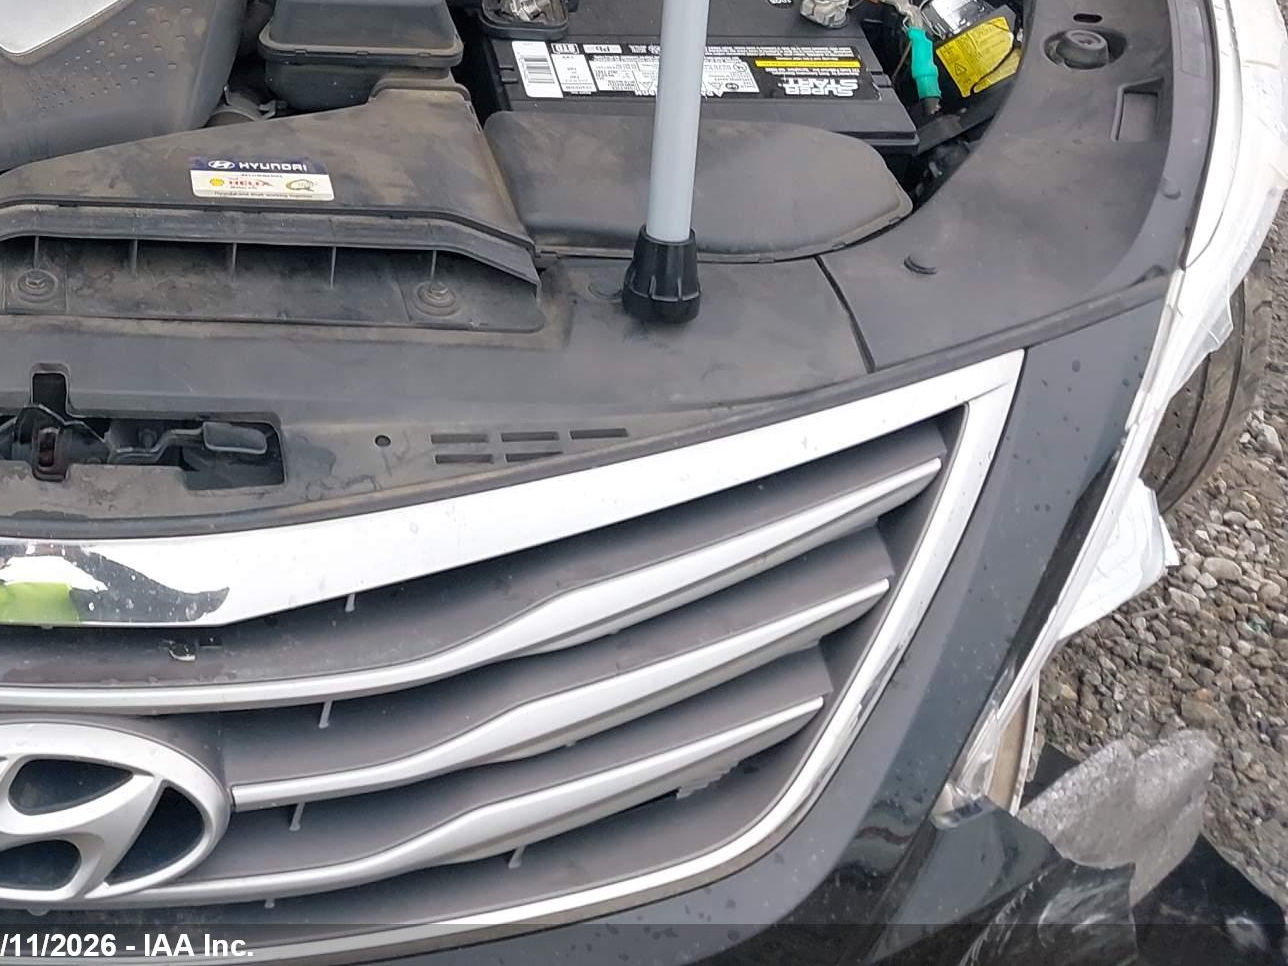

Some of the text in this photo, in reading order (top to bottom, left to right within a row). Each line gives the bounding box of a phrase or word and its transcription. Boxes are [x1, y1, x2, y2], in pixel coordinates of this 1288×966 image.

[782, 78, 859, 90] START
[784, 85, 854, 97] SUPER
[238, 161, 308, 172] HYUNDAI
